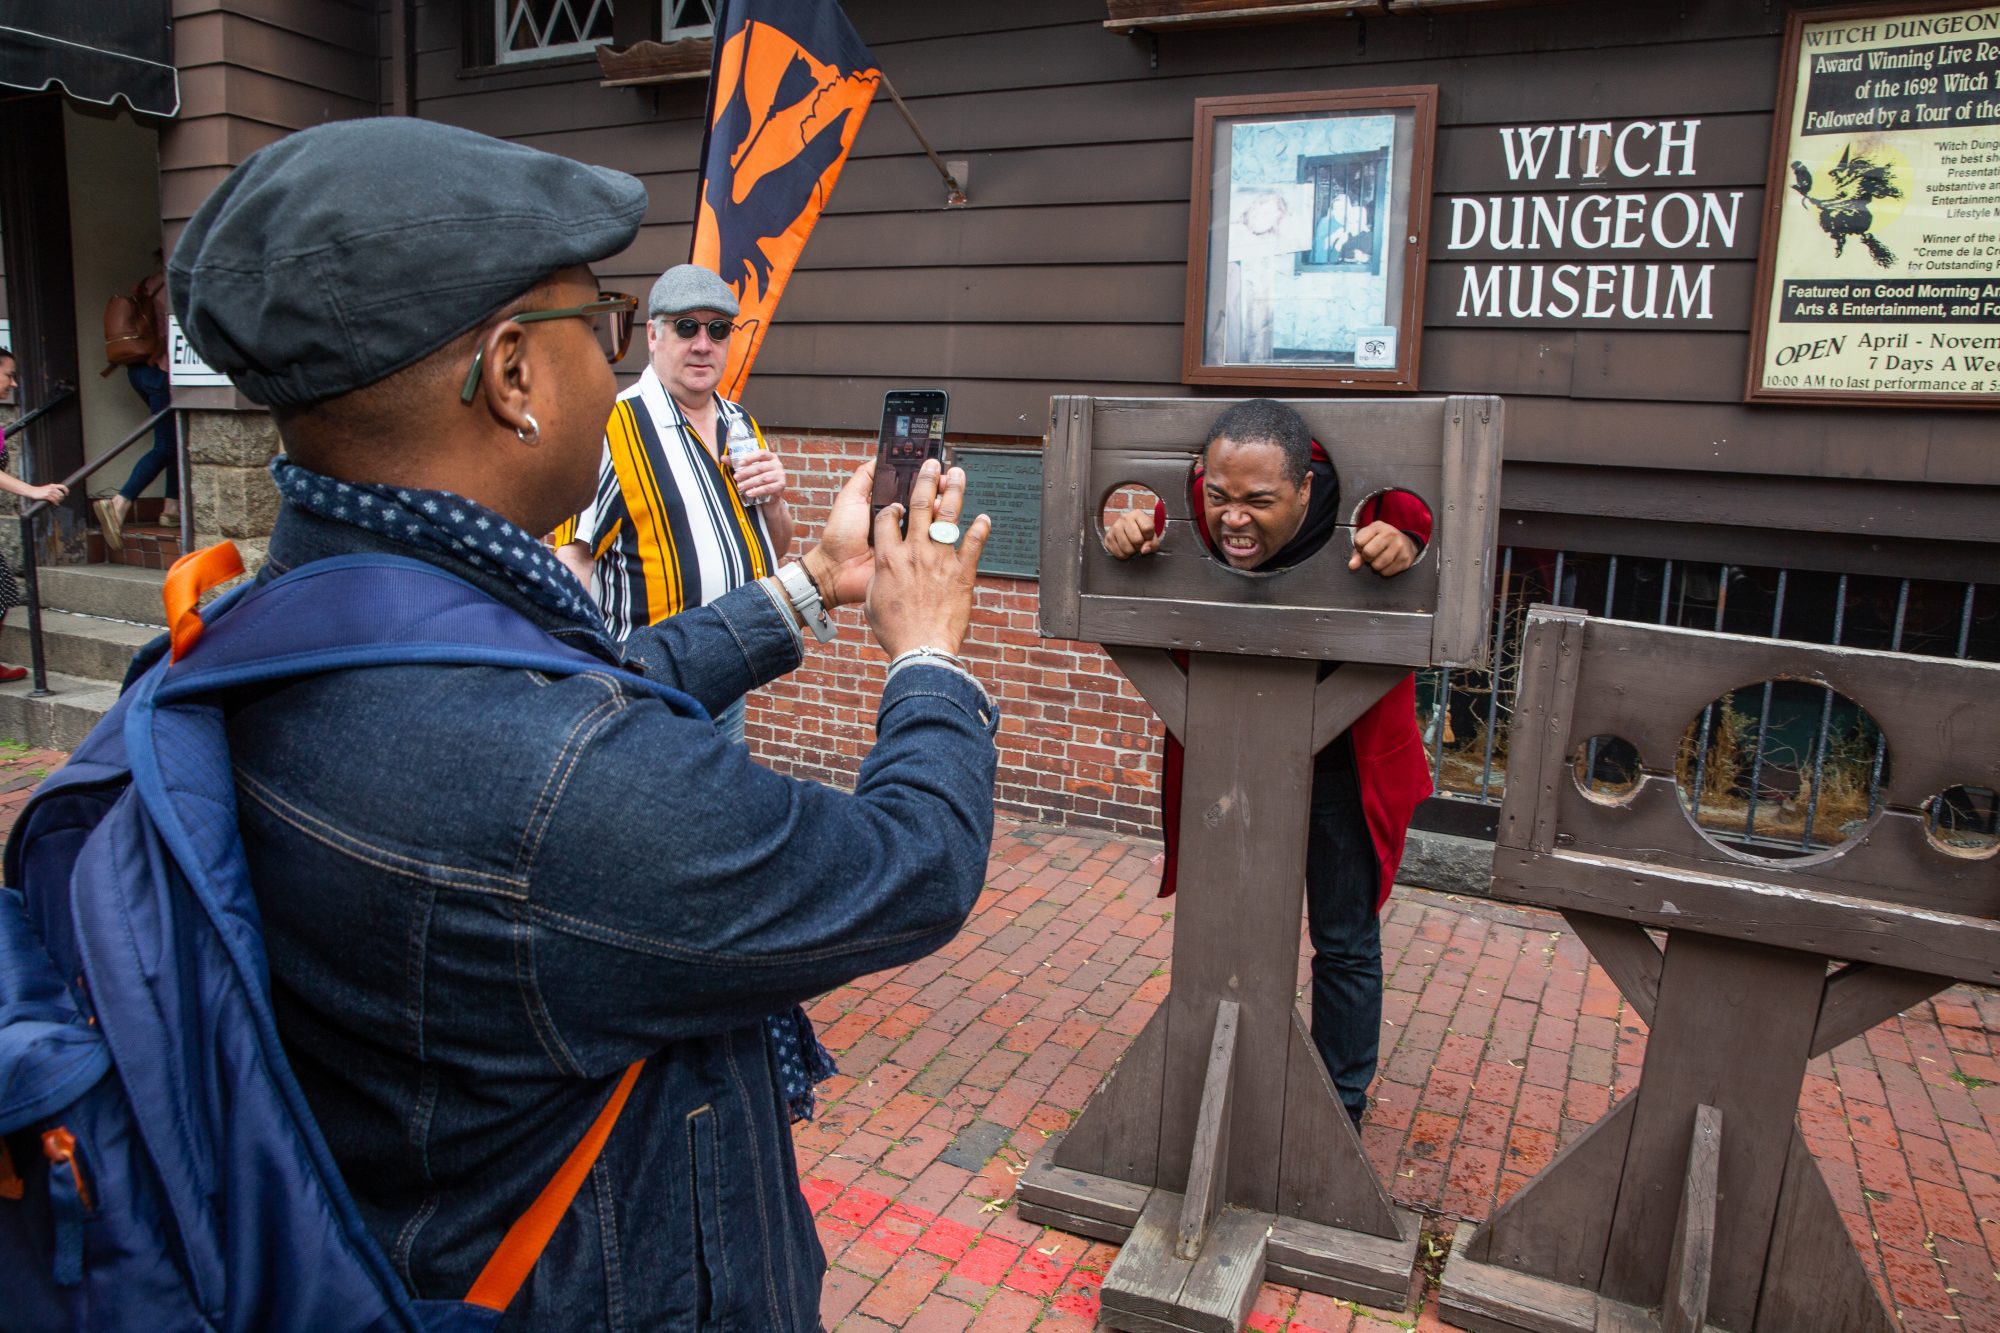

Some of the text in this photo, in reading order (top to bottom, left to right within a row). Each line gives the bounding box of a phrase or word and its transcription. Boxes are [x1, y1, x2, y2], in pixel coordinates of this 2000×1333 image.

[1805, 13, 2000, 47] WITCH DUNGEON
[1815, 53, 1863, 73] Award
[1868, 49, 1933, 70] Winning
[1938, 45, 1973, 65] Live
[1855, 80, 1872, 99] of
[1874, 79, 1899, 98] the
[1903, 77, 1938, 96] 1692
[1943, 72, 1988, 93] Witch
[1806, 100, 2000, 129] Followed by a Tour of the
[1500, 120, 1701, 180] WITCH
[1971, 139, 2000, 151] Dung
[1941, 153, 2000, 165] the best sh
[1926, 182, 1986, 192] substantive
[1447, 192, 1744, 250] DUNGEON
[1947, 207, 1991, 220] Lifestyle
[1923, 233, 1961, 243] Winner
[1964, 233, 1976, 243] of
[1978, 233, 1996, 243] the
[1956, 247, 1970, 256] de
[1973, 247, 1983, 256] la
[1986, 246, 2000, 256] Cr
[1907, 260, 1923, 271] for
[1926, 260, 1993, 272] Outstanding
[1456, 264, 1715, 319] MUSEUM
[1788, 285, 1850, 298] Featured
[1852, 287, 1871, 298] on
[1874, 285, 1915, 298] Good
[1917, 284, 1980, 301] Morning
[1795, 302, 2000, 318] Arts & Entertainment, and Fo
[1776, 335, 1848, 366] OPEN
[1858, 333, 1909, 351] April
[1929, 333, 2000, 349] Novem
[1869, 356, 1878, 370] 7
[1885, 355, 1934, 374] Days
[1941, 356, 1957, 371] A
[1767, 375, 1798, 387] 10:00
[1804, 375, 1826, 387] AM
[1830, 377, 1843, 388] to
[1846, 376, 1870, 388] last
[1874, 376, 1967, 391] performance
[1971, 380, 1985, 391] at
